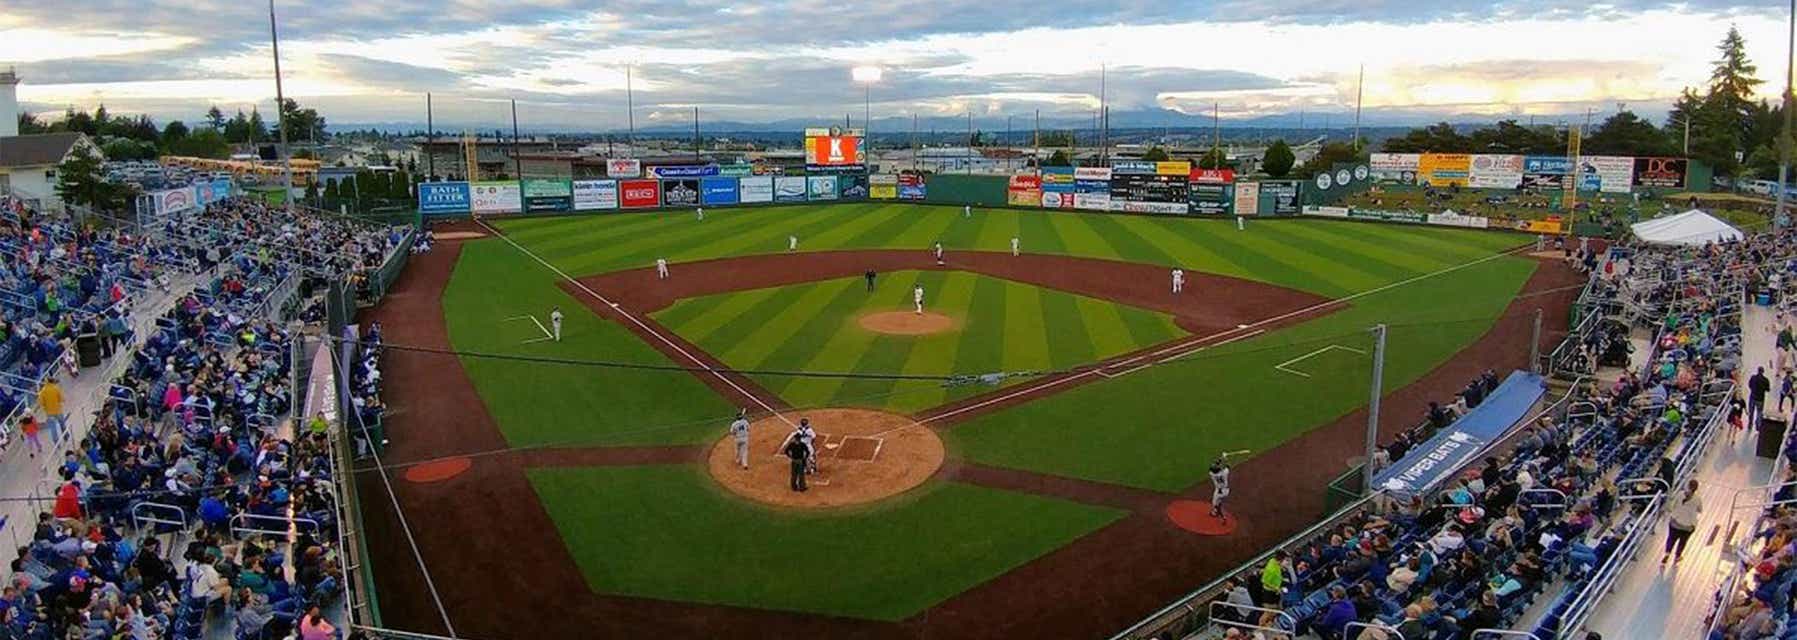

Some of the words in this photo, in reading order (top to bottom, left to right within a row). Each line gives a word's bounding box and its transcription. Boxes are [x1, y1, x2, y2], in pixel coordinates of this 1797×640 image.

[830, 138, 842, 156] K
[1648, 159, 1677, 174] DC
[431, 186, 460, 194] BATH
[427, 194, 464, 202] FITTER
[1403, 457, 1438, 481] VIPER
[1432, 440, 1461, 462] BATS
